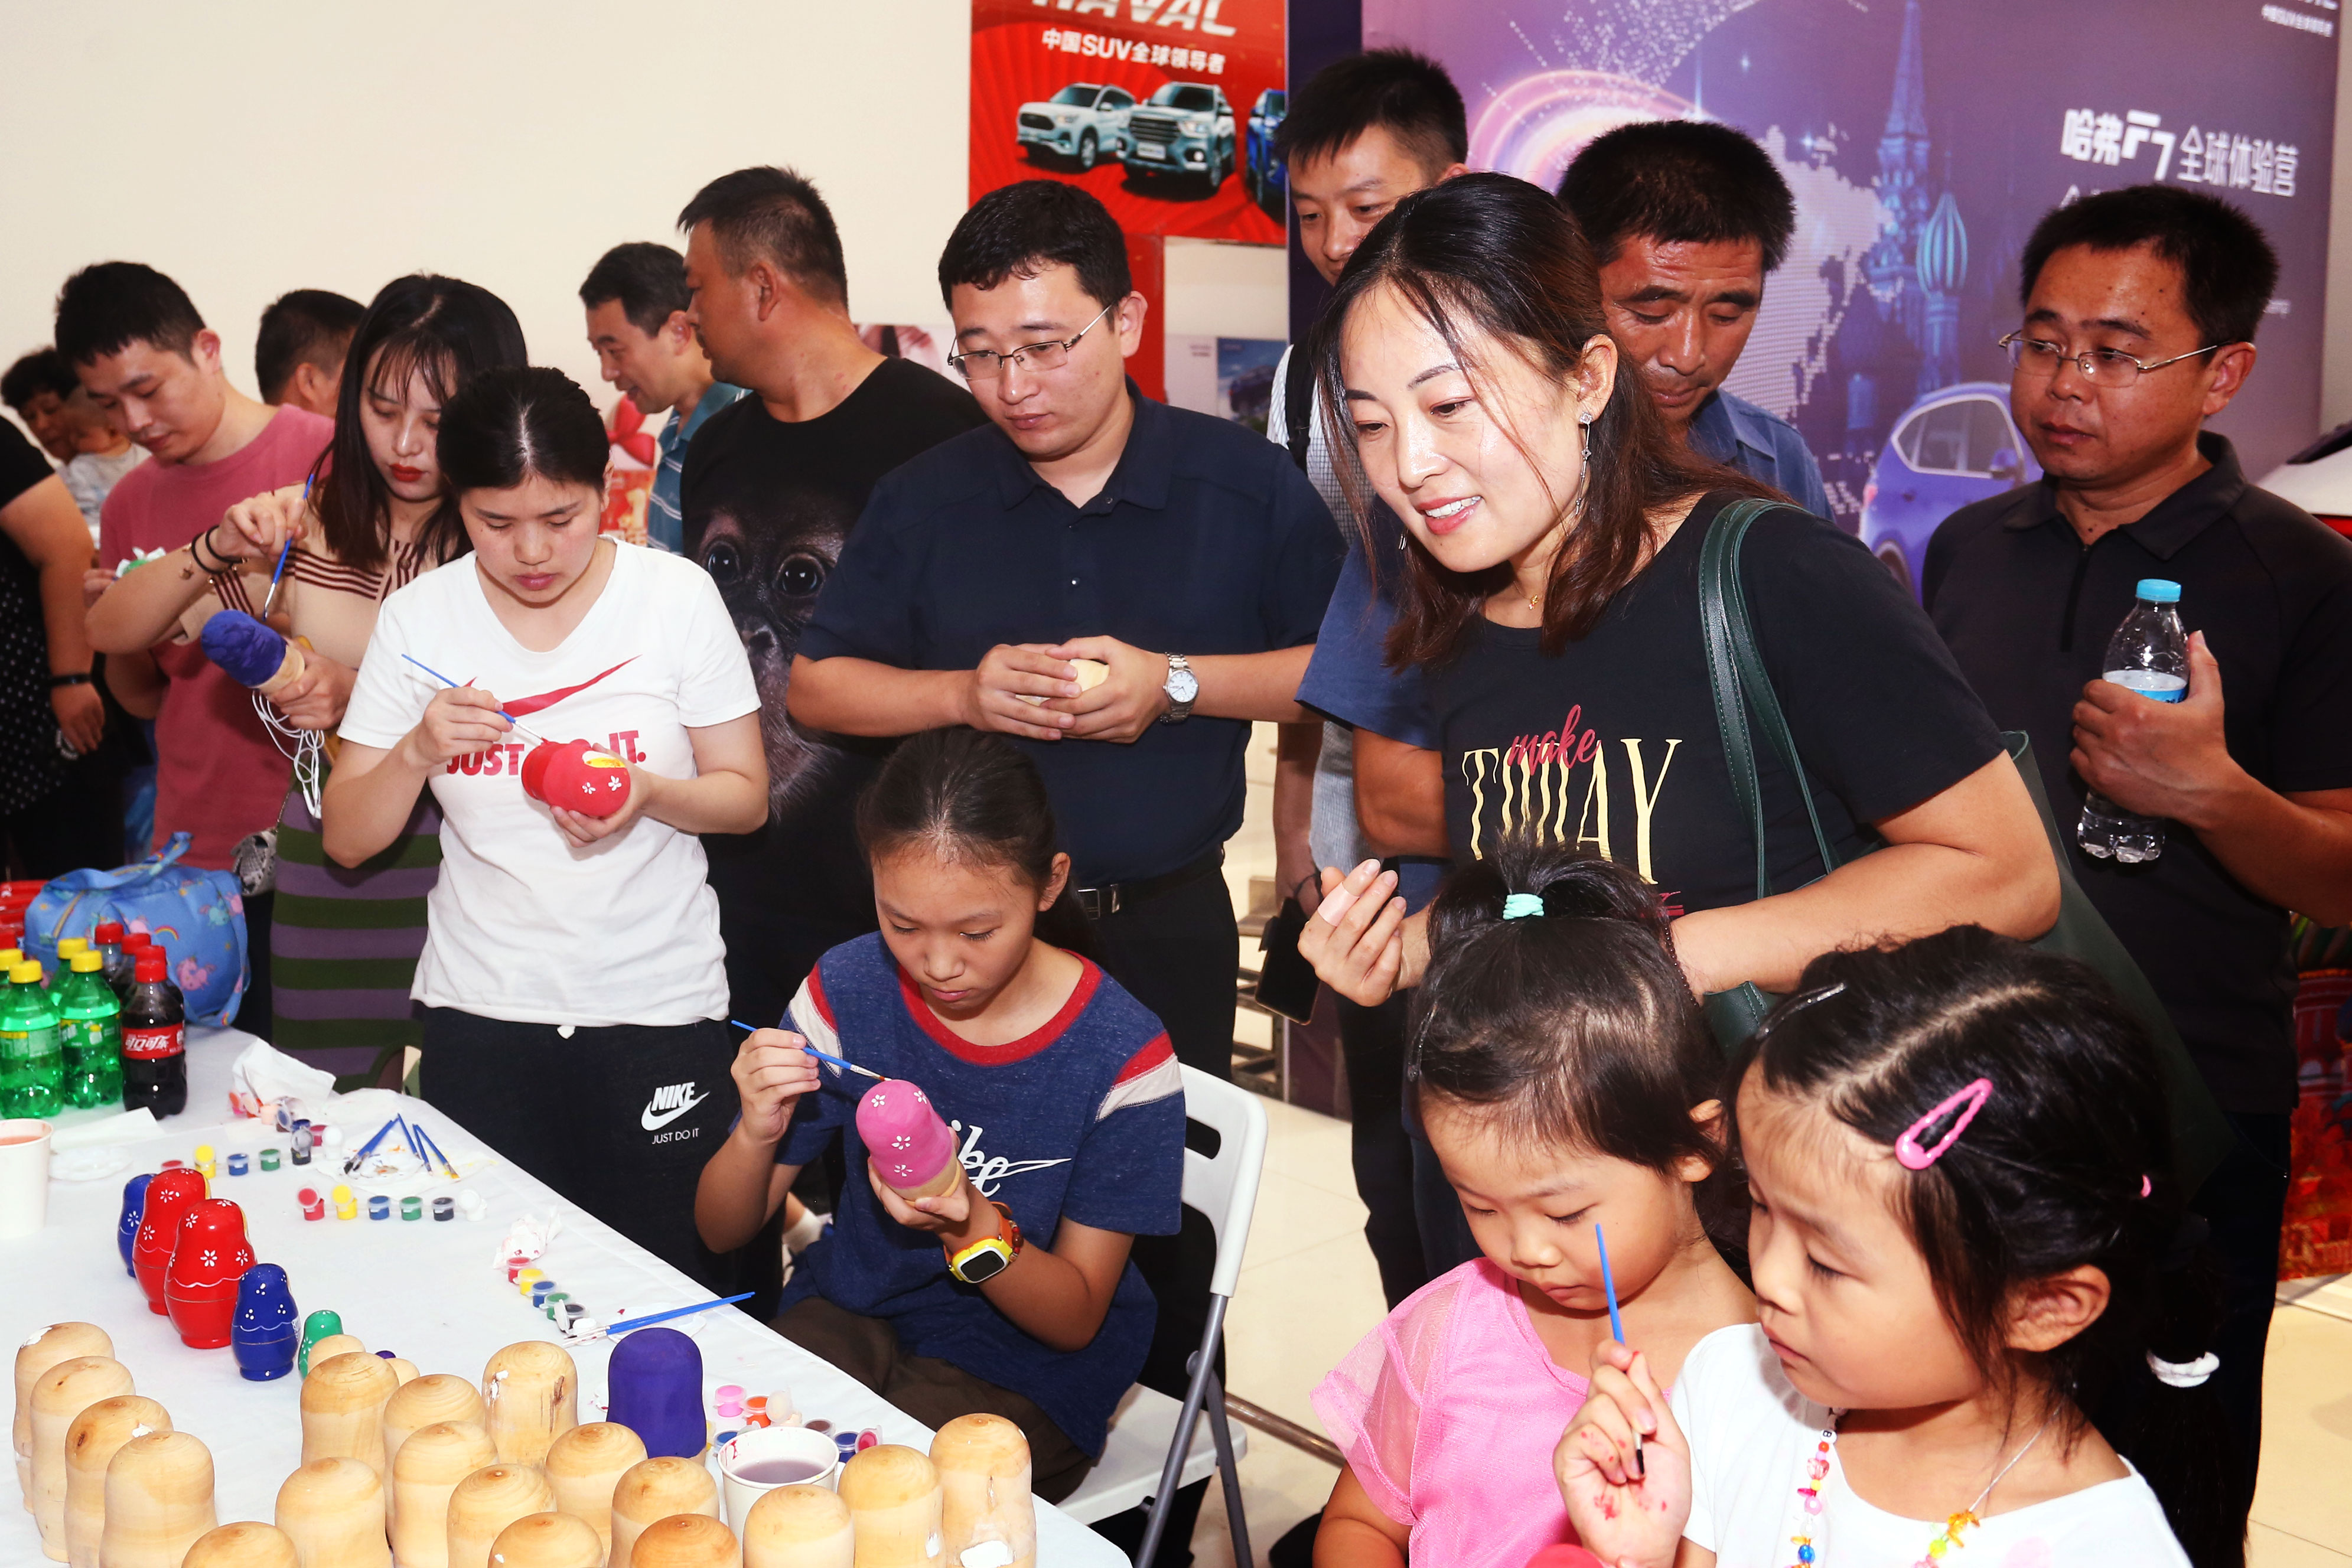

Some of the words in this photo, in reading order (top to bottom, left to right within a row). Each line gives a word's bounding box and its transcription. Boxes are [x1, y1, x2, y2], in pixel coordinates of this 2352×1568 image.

[1032, 0, 1236, 37] VAL
[1042, 28, 1226, 75] 中国SUV全球领导者
[1507, 704, 1601, 775] make
[447, 743, 525, 775] JUST
[651, 1082, 695, 1111] NIKE
[652, 1132, 673, 1145] JUST
[675, 1130, 690, 1141] DO
[692, 1128, 699, 1137] IT
